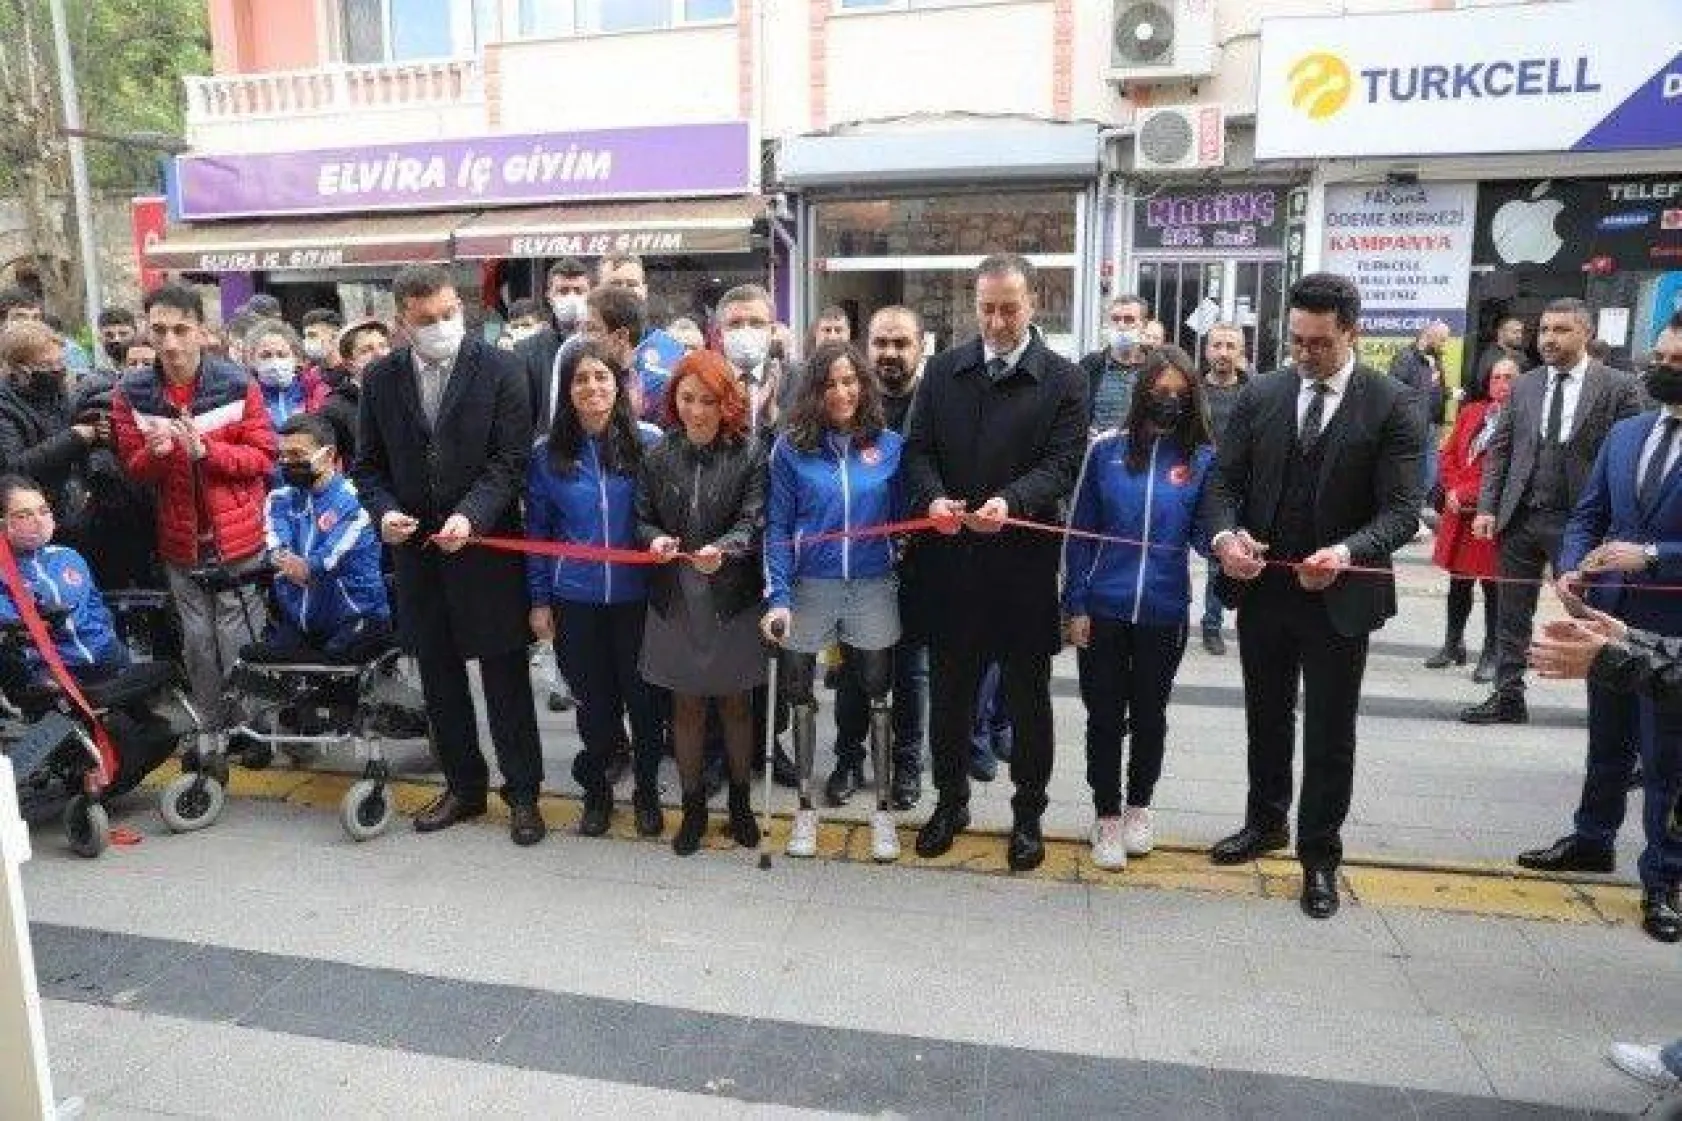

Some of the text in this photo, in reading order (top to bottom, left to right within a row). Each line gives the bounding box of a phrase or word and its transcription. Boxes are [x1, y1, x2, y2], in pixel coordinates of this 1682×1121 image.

[1361, 57, 1600, 103] TURKCELL
[317, 152, 446, 195] ELVİRA
[502, 143, 612, 183] GİYİM
[1329, 235, 1451, 251] KAMPANYA
